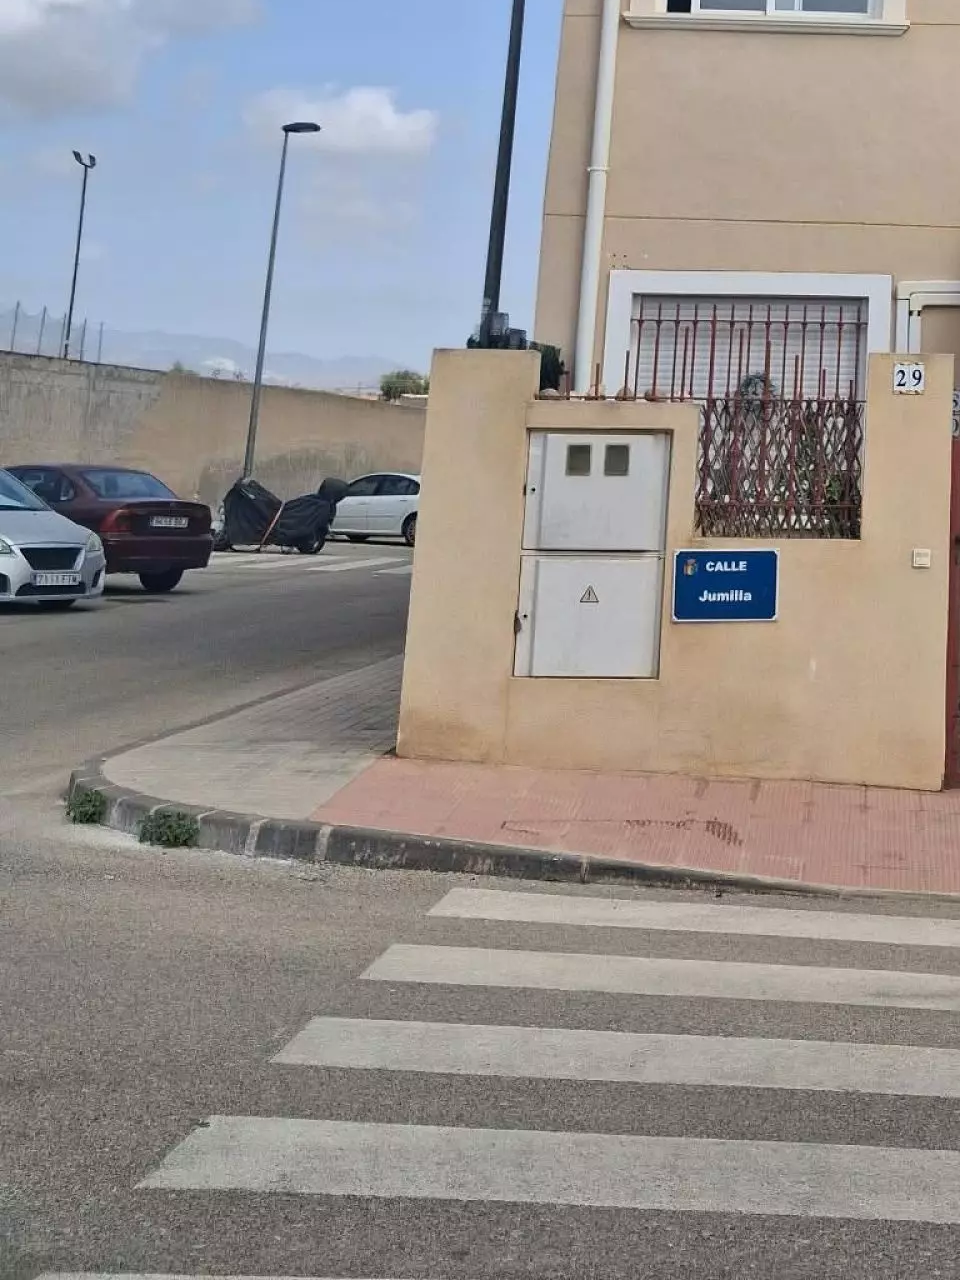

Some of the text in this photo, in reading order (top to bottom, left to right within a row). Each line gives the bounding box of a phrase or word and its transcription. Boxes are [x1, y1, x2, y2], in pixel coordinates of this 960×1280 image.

[895, 369, 922, 387] 29
[705, 560, 748, 572] CALLE
[698, 589, 752, 602] Jumilla
